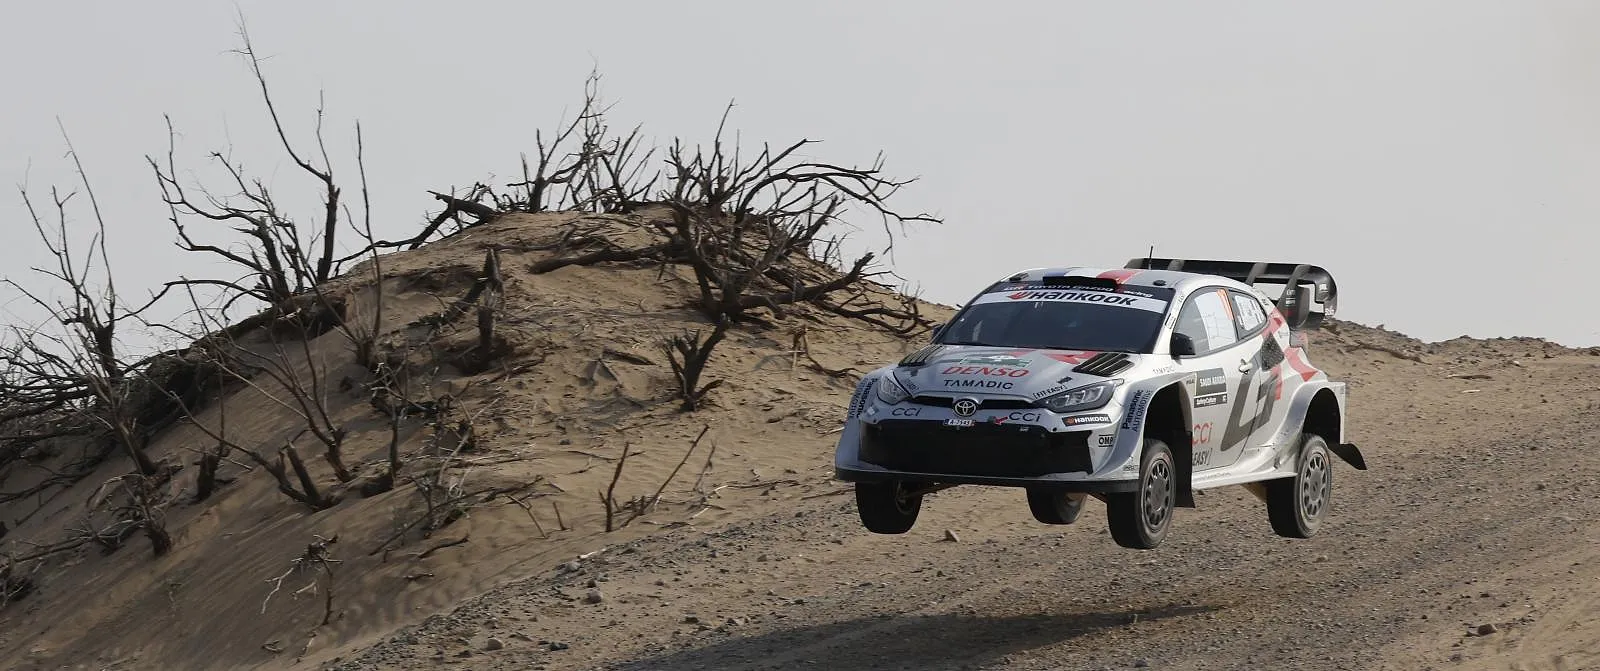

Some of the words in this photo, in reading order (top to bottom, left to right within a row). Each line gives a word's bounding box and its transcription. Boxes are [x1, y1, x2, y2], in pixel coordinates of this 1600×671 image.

[942, 366, 1030, 378] DENSO
[943, 379, 1014, 390] TAMADIC
[1122, 390, 1144, 430] Panasonic
[1132, 389, 1153, 432] AUTOMOTIVE
[1098, 436, 1114, 446] OMP
